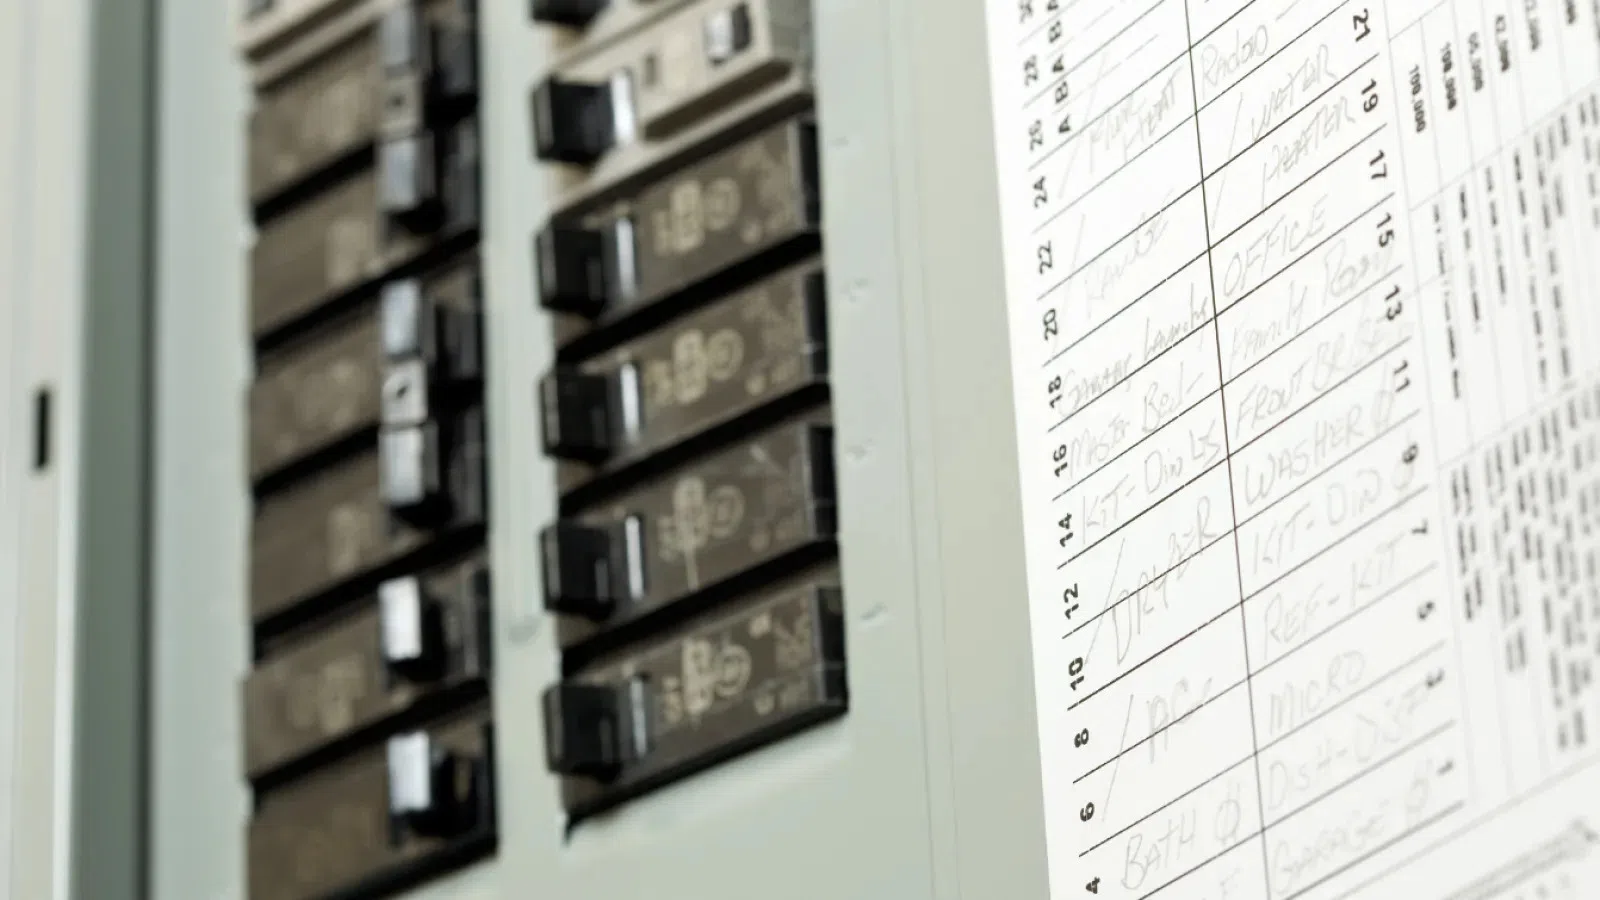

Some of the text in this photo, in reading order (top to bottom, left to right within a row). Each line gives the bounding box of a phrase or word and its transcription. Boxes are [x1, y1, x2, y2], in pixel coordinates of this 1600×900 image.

[1353, 7, 1371, 43] 21
[1051, 53, 1065, 73] A
[1054, 80, 1069, 105] B
[1360, 78, 1379, 113] 19
[1409, 65, 1426, 134] 100,000
[1028, 118, 1044, 152] 26
[1057, 113, 1072, 135] A
[1369, 149, 1388, 180] 17
[1032, 175, 1048, 209] 24
[1224, 193, 1328, 298] OFFICE
[1376, 211, 1395, 248] 15
[1037, 240, 1053, 275] 22
[1384, 284, 1403, 322] 13
[1042, 308, 1059, 341] 20
[1047, 374, 1063, 409] 18
[1392, 359, 1412, 394] 11
[1052, 443, 1069, 478] 16
[1245, 403, 1364, 507] WASHER
[1402, 441, 1420, 466] 9
[1057, 512, 1074, 548] 14
[1410, 517, 1429, 536] 7
[1062, 582, 1080, 619] 12
[1417, 600, 1435, 622] 5
[1068, 656, 1085, 691] 10
[1268, 650, 1365, 736] MICRO
[1073, 728, 1090, 748] 8
[1436, 760, 1454, 777] 1
[1080, 802, 1096, 823] 6
[1122, 808, 1196, 891] BATH
[1085, 876, 1101, 895] 4
